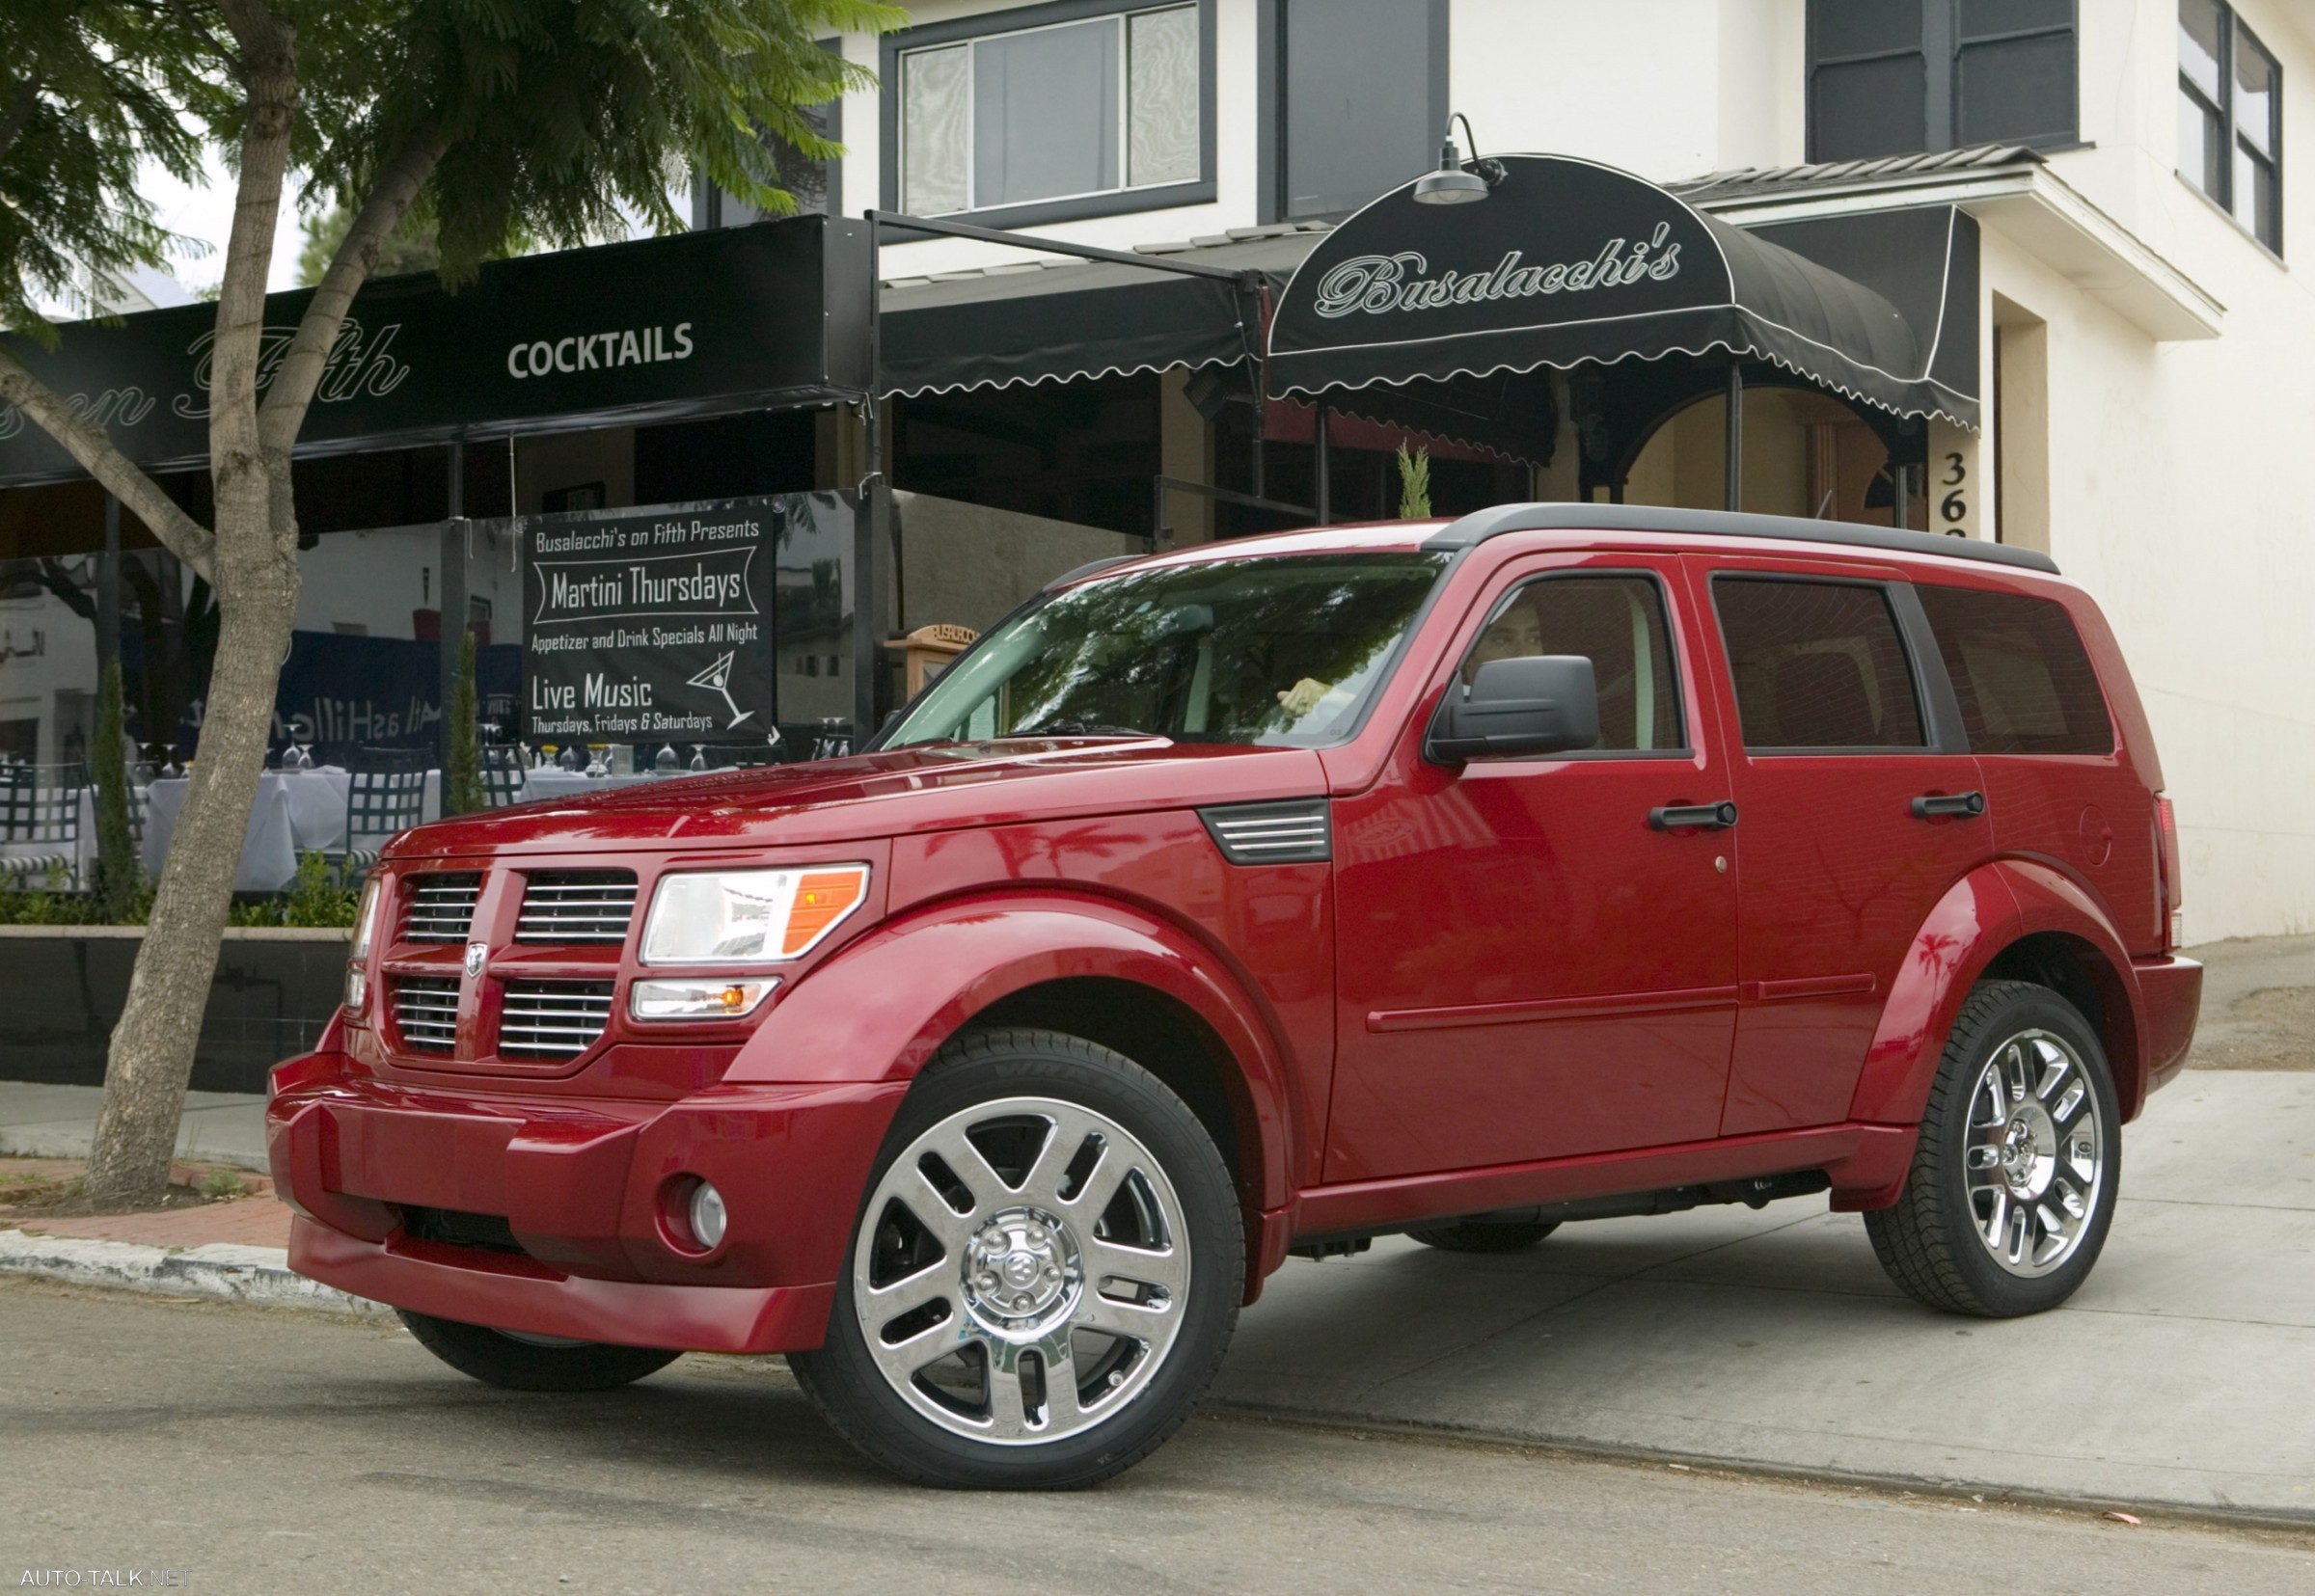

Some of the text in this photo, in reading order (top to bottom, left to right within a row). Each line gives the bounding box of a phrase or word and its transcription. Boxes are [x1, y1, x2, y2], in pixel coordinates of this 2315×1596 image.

[1314, 221, 1681, 318] Busalacchi's
[173, 317, 410, 419] Fth
[507, 322, 694, 379] COCKTAILS
[1941, 451, 1967, 539] 36
[536, 520, 759, 553] Busalacchi's on Fifth Presents
[551, 562, 741, 609] Martini Thursdays
[531, 622, 758, 655] Appetizer and Drink Specials All Night
[532, 675, 576, 710] Live
[584, 672, 653, 708] Music
[531, 711, 713, 736] Thursdays, Fridays & Saturdays
